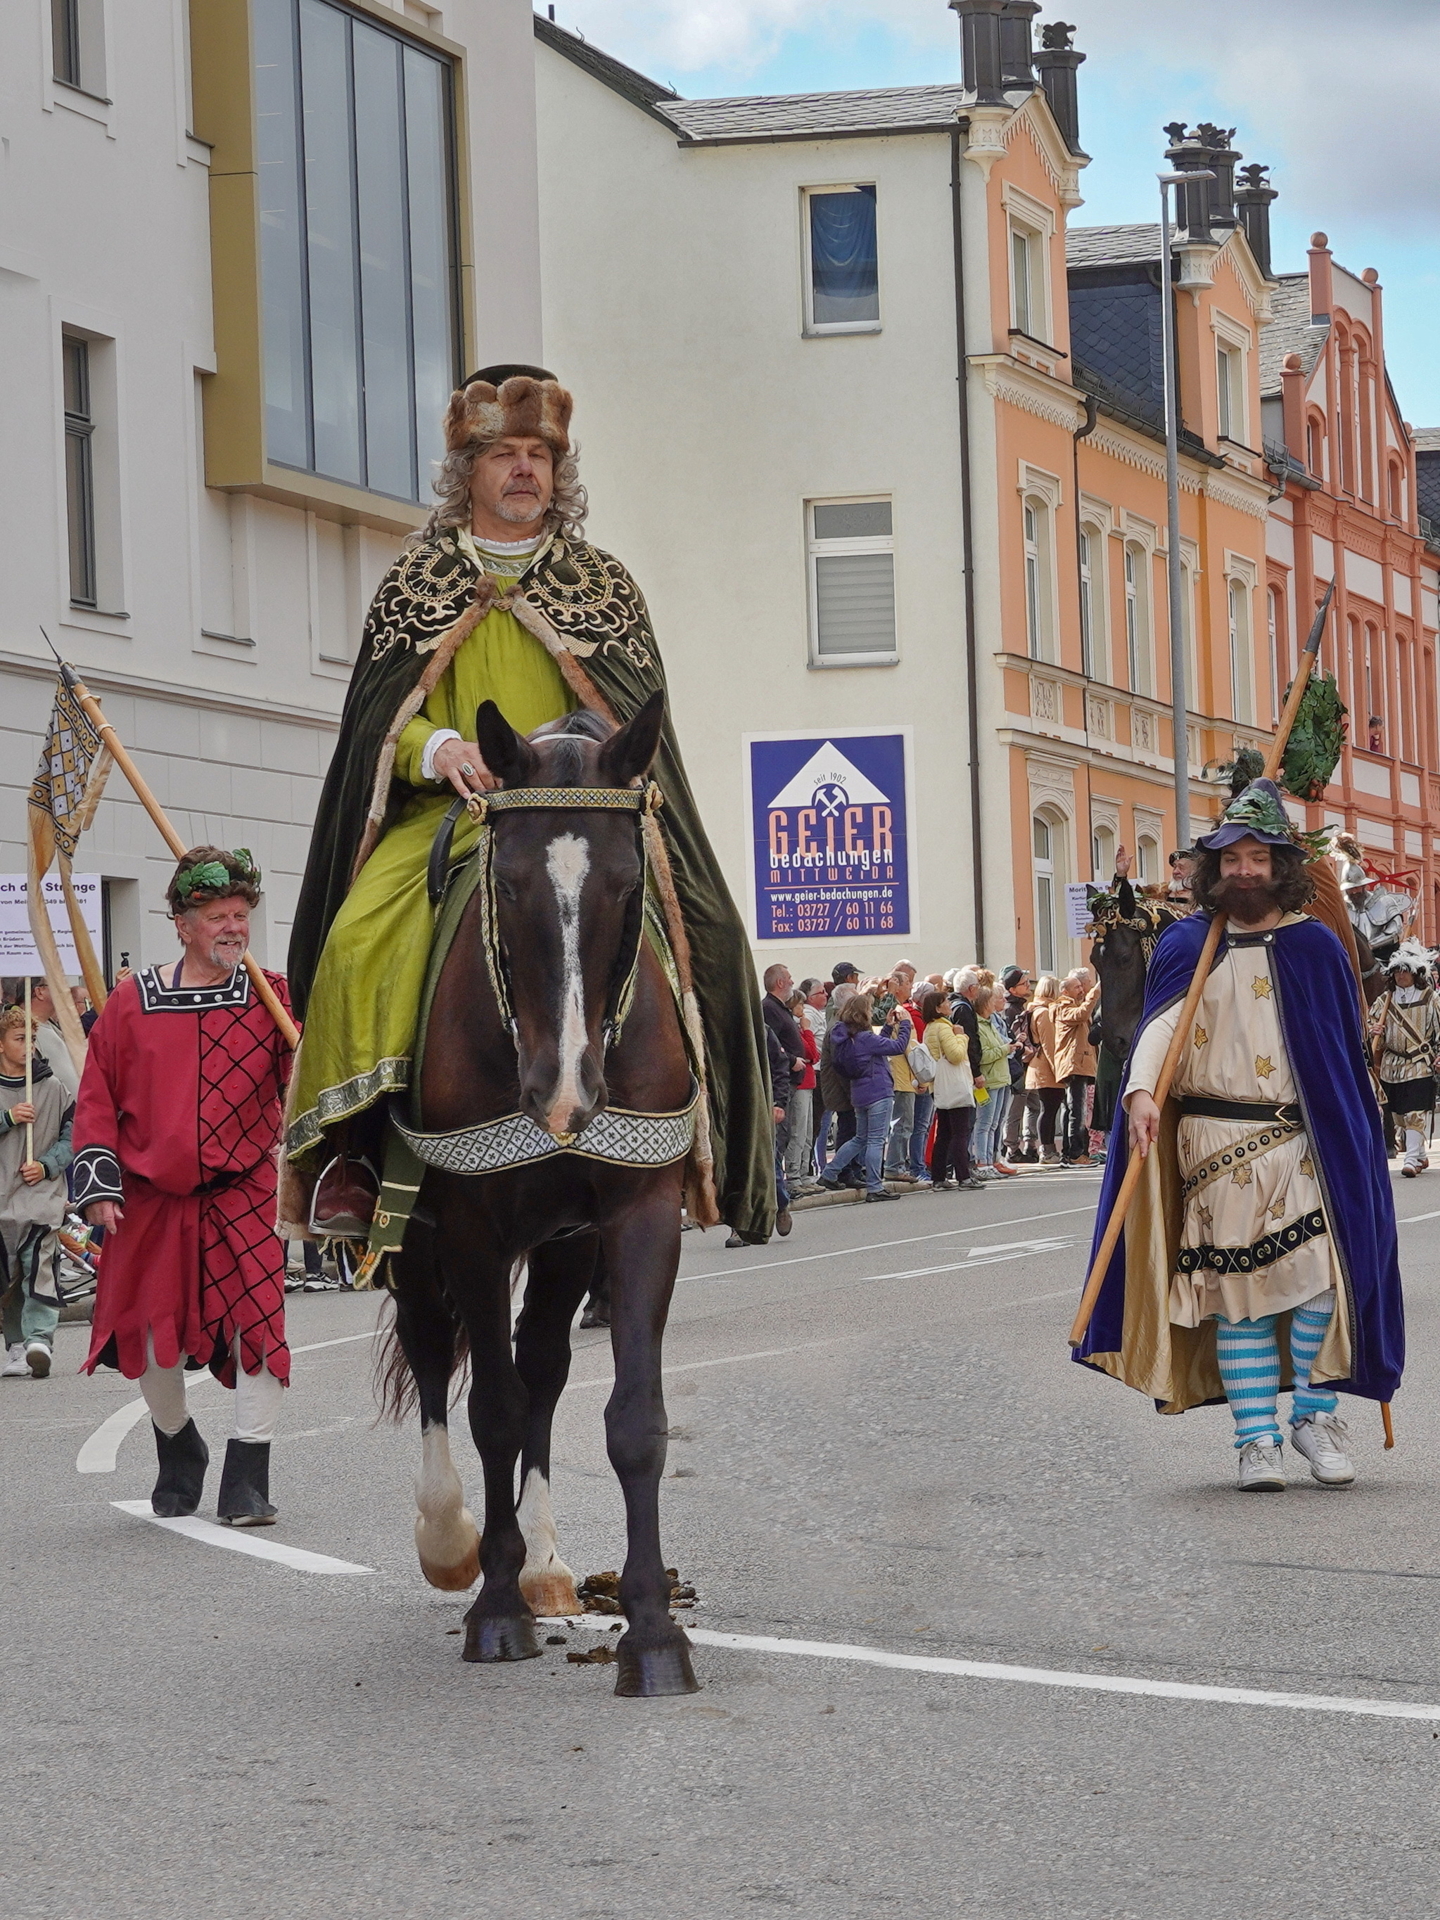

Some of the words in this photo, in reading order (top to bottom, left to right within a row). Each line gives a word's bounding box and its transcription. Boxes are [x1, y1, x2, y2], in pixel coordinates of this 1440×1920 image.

[813, 774, 826, 786] seit
[830, 772, 847, 785] 1902
[768, 806, 892, 859] GEIER
[769, 846, 893, 870] bedachungen
[770, 866, 893, 883] MITTWEIDA
[45, 882, 96, 893] Strnge
[770, 886, 893, 903] www.geier-bedachungen.de
[771, 904, 793, 918] Tel.:
[797, 903, 830, 917] 03727
[846, 902, 859, 915] 60
[864, 902, 874, 914] 11
[880, 901, 893, 914] 66
[772, 920, 794, 933] Fax:
[798, 918, 830, 932] 03727
[846, 917, 860, 930] 60
[865, 917, 875, 929] 11
[880, 916, 894, 929] 68
